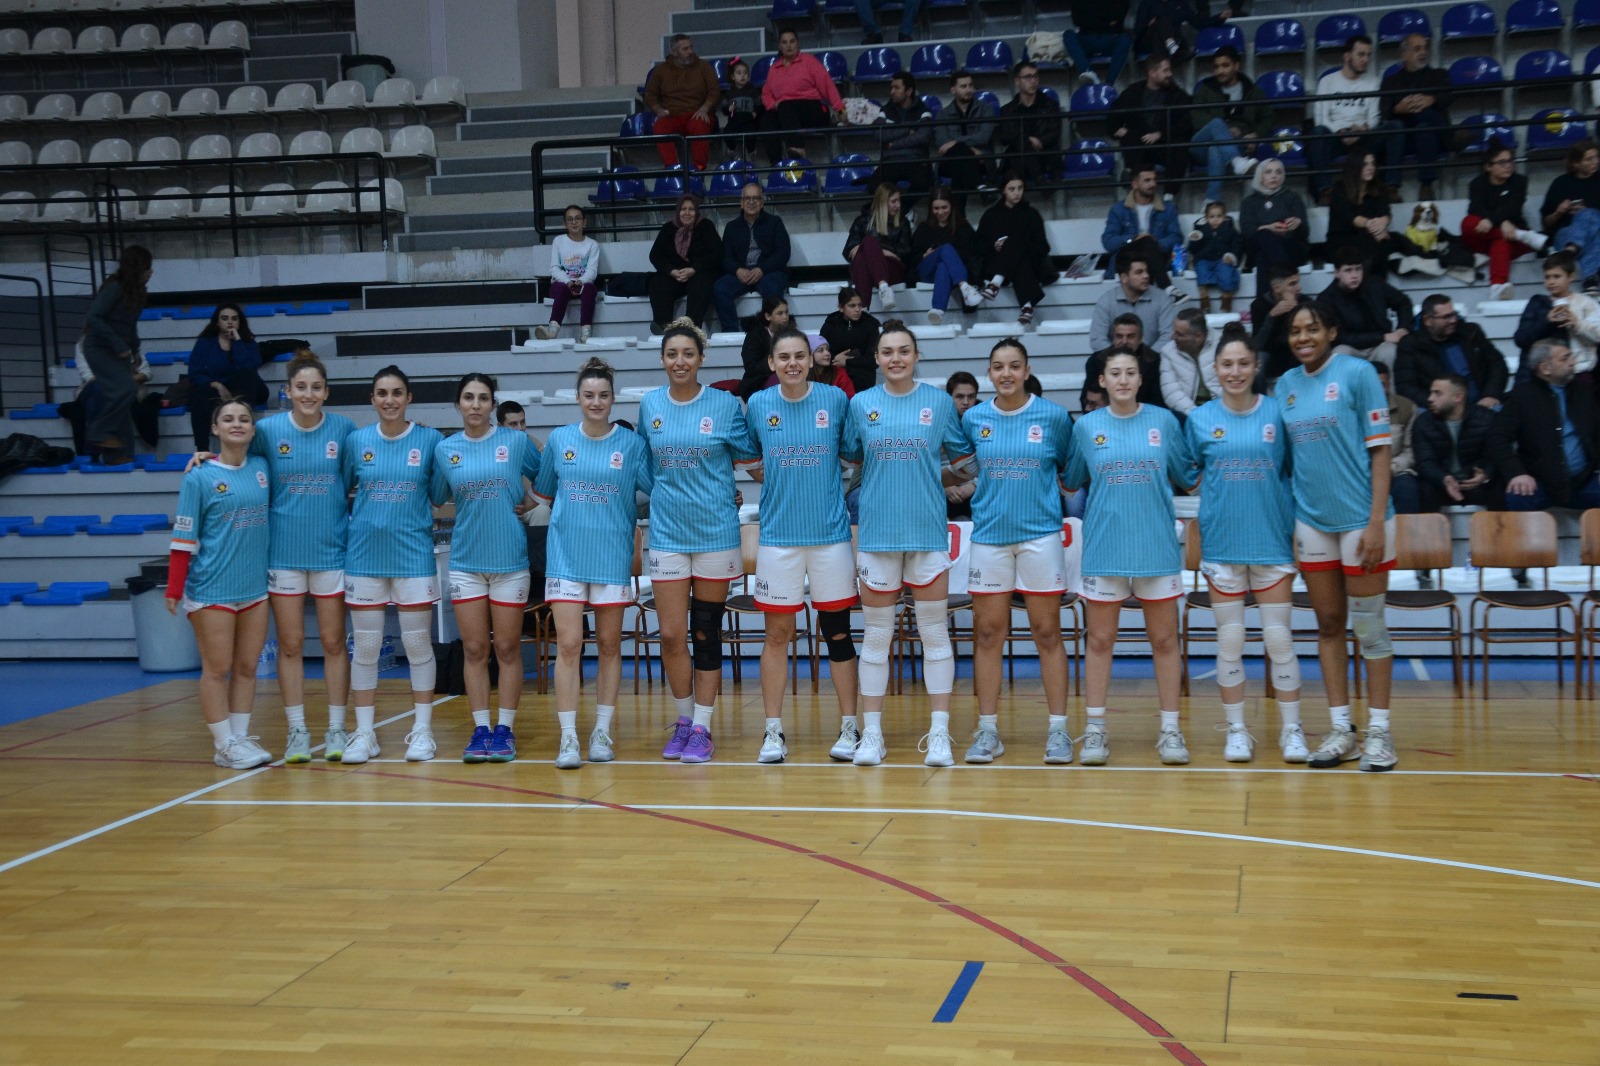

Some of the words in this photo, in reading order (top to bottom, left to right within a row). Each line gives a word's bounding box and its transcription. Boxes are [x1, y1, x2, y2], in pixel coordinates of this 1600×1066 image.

[770, 445, 831, 457] KARAATA
[877, 451, 919, 461] BETON
[660, 459, 700, 469] BETON
[780, 457, 820, 467] BETON
[989, 470, 1029, 480] BETON
[1106, 474, 1151, 486] BETON
[289, 485, 328, 495] BETON
[370, 492, 407, 502] BETON
[570, 493, 609, 504] BETON
